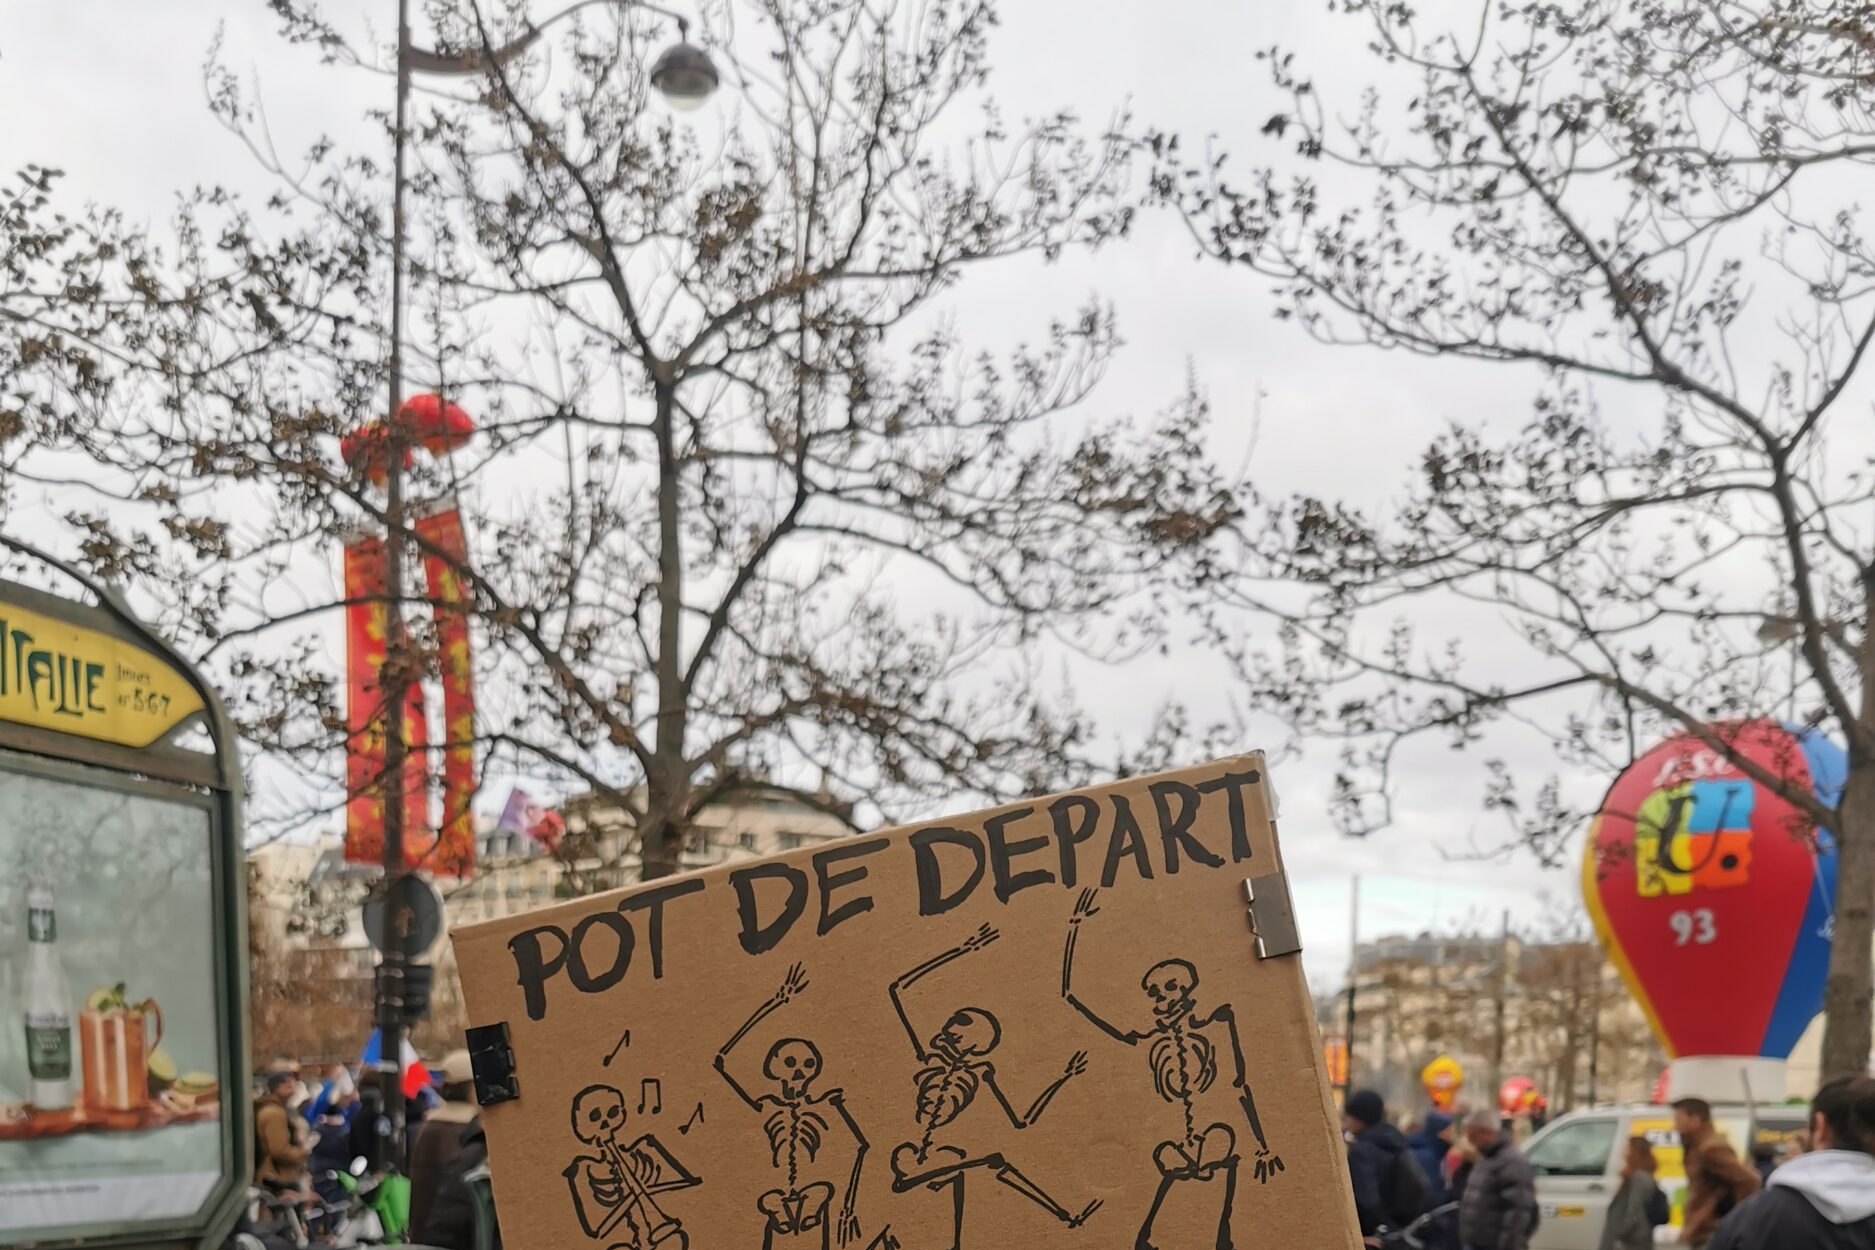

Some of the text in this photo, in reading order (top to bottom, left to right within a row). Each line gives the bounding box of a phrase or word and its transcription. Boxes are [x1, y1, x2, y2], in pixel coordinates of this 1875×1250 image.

[507, 771, 1261, 1020] POT DE DEPART
[1669, 907, 1718, 945] 93
